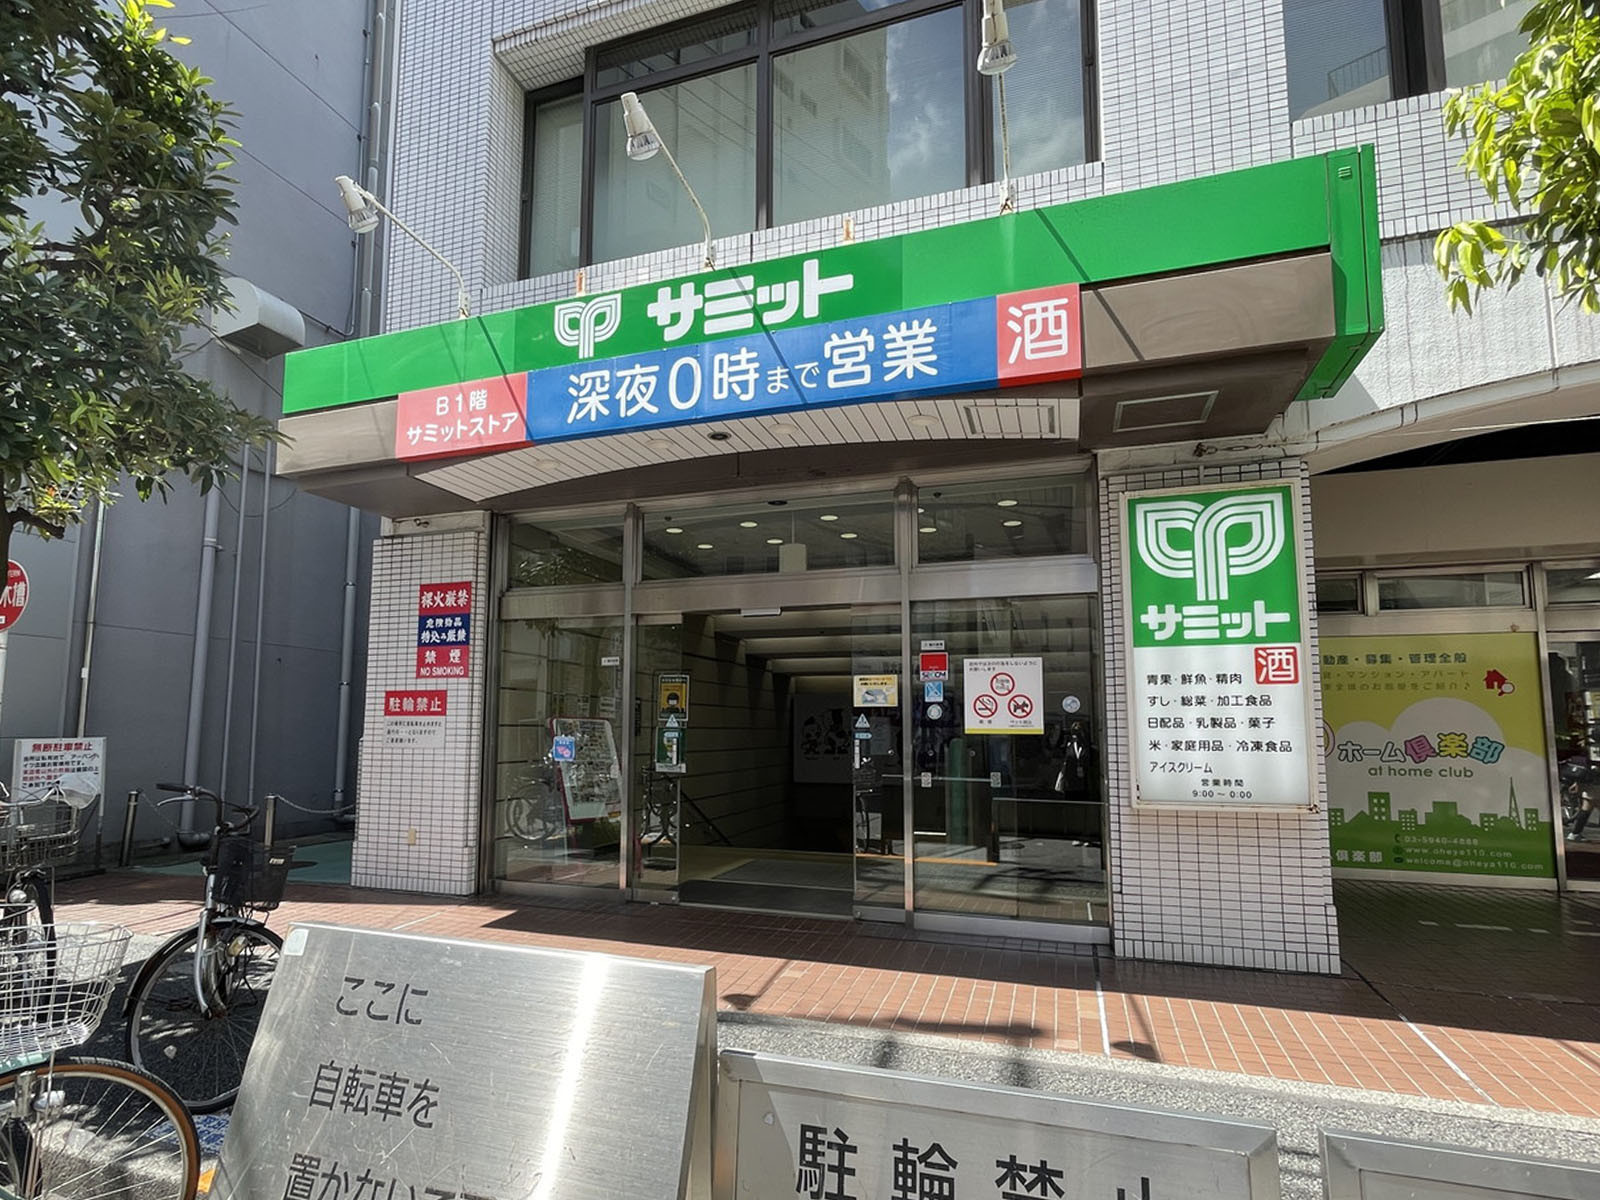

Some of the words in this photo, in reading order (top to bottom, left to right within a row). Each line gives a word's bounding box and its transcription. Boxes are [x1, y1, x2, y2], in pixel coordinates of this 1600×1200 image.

[647, 258, 855, 342] サミット
[1006, 297, 1069, 365] 酒
[566, 318, 939, 424] 深夜0時まで営業
[435, 390, 488, 416] B1階
[406, 411, 519, 446] サミットストア
[1139, 600, 1292, 641] サミット
[419, 667, 431, 676] NO
[432, 665, 464, 677] SMOKING
[1257, 648, 1297, 684] 酒
[1146, 673, 1243, 686] 青果・鮮魚・精肉
[389, 696, 442, 712] 駐輪禁止
[1147, 716, 1276, 729] 日配品・乳製品・菓子
[32, 742, 93, 753] 無断駐車禁止
[1148, 739, 1293, 753] 米・家庭用品・冷凍食品
[1149, 761, 1213, 774] アイスクリーム
[1368, 766, 1386, 777] at
[1387, 765, 1433, 778] home
[1438, 766, 1474, 779] club
[1200, 778, 1245, 788] 営業時間
[335, 976, 429, 1026] ここに
[308, 1060, 441, 1129] 自転車を
